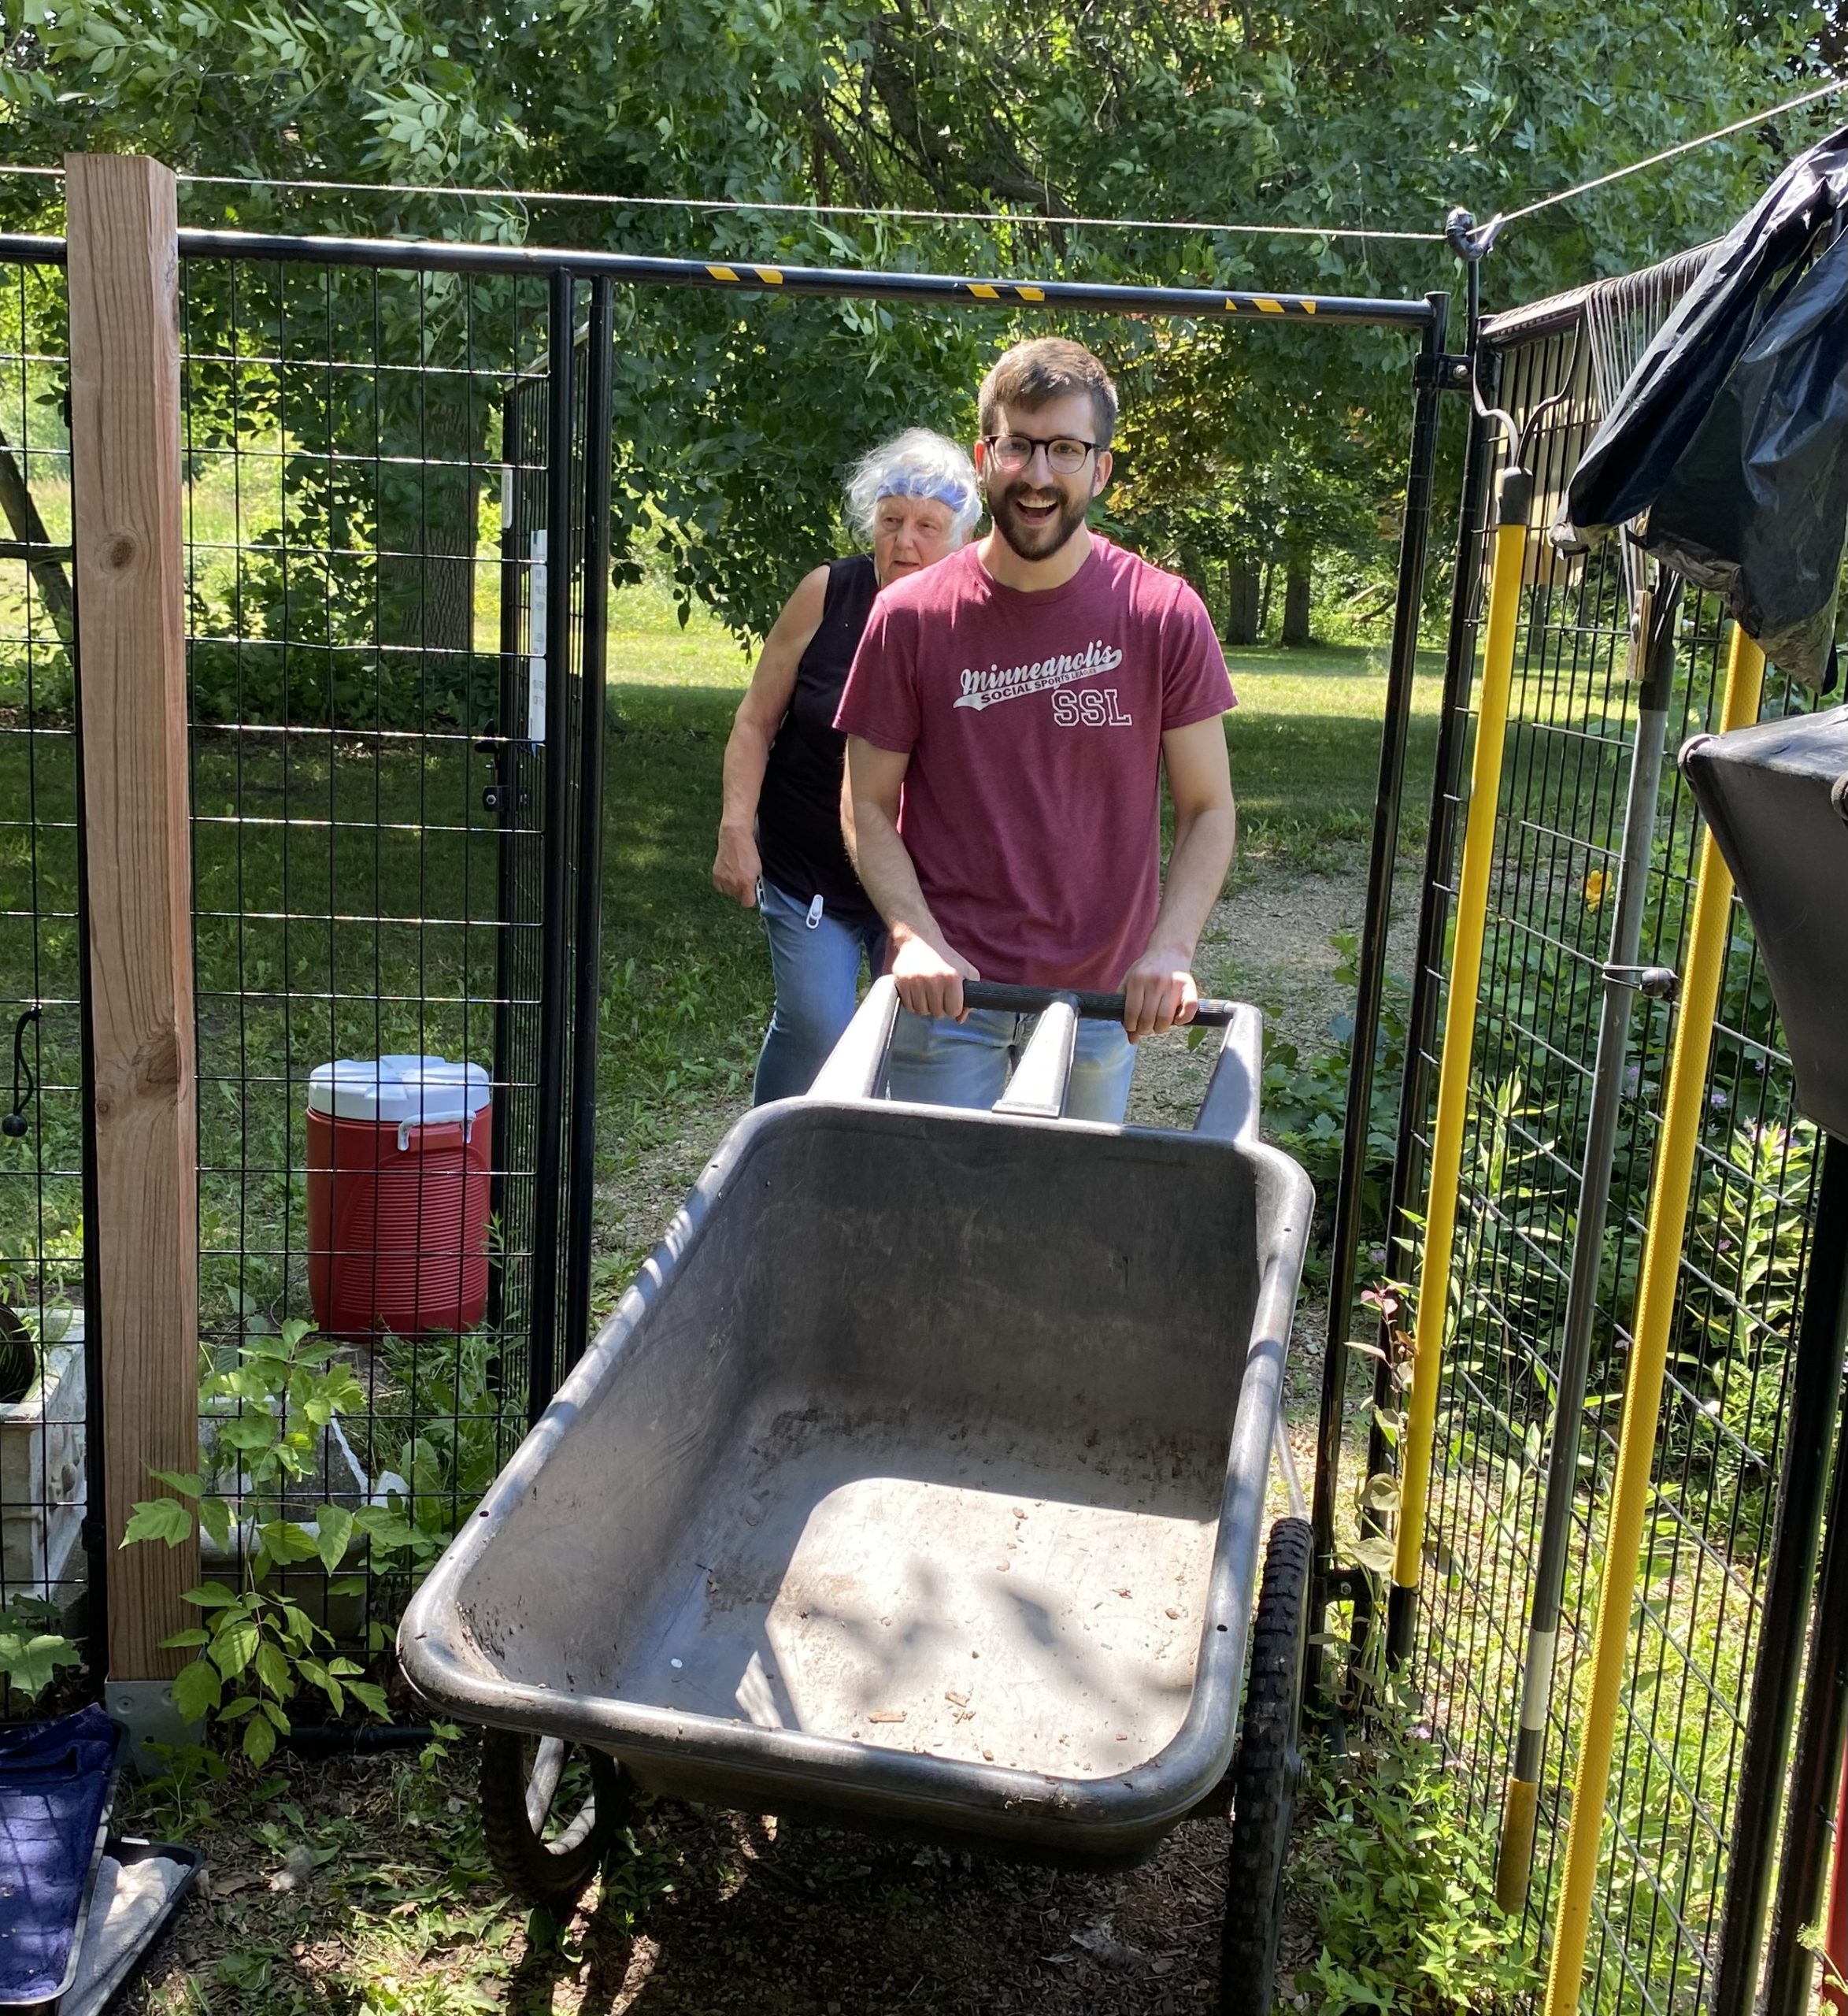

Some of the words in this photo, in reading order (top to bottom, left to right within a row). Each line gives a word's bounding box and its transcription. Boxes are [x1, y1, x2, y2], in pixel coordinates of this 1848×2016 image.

[961, 640, 1112, 695] Minneapolis
[981, 684, 1031, 703] SOCIAL
[1035, 673, 1070, 689] SPORTS
[1072, 668, 1097, 679] LEAGUES
[1052, 689, 1132, 726] SSL
